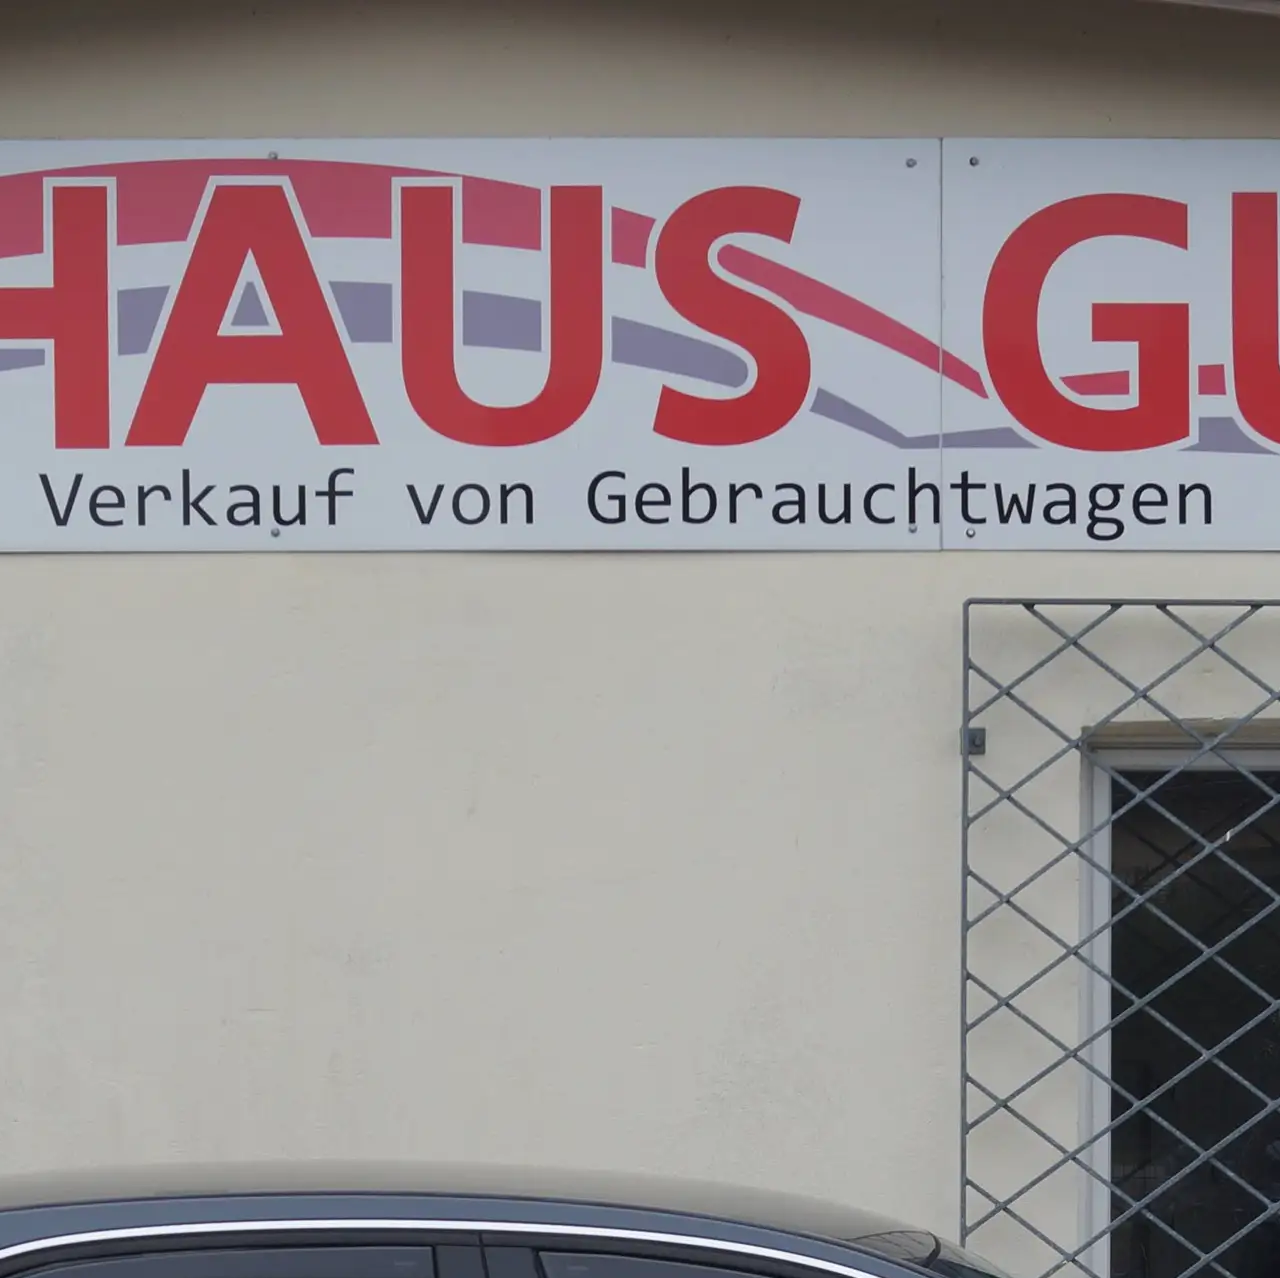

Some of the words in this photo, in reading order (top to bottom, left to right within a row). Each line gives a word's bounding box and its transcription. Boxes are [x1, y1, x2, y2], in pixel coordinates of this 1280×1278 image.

[38, 467, 356, 527] Verkauf
[405, 483, 535, 526] von
[586, 466, 1213, 541] Gebrauchtwagen
